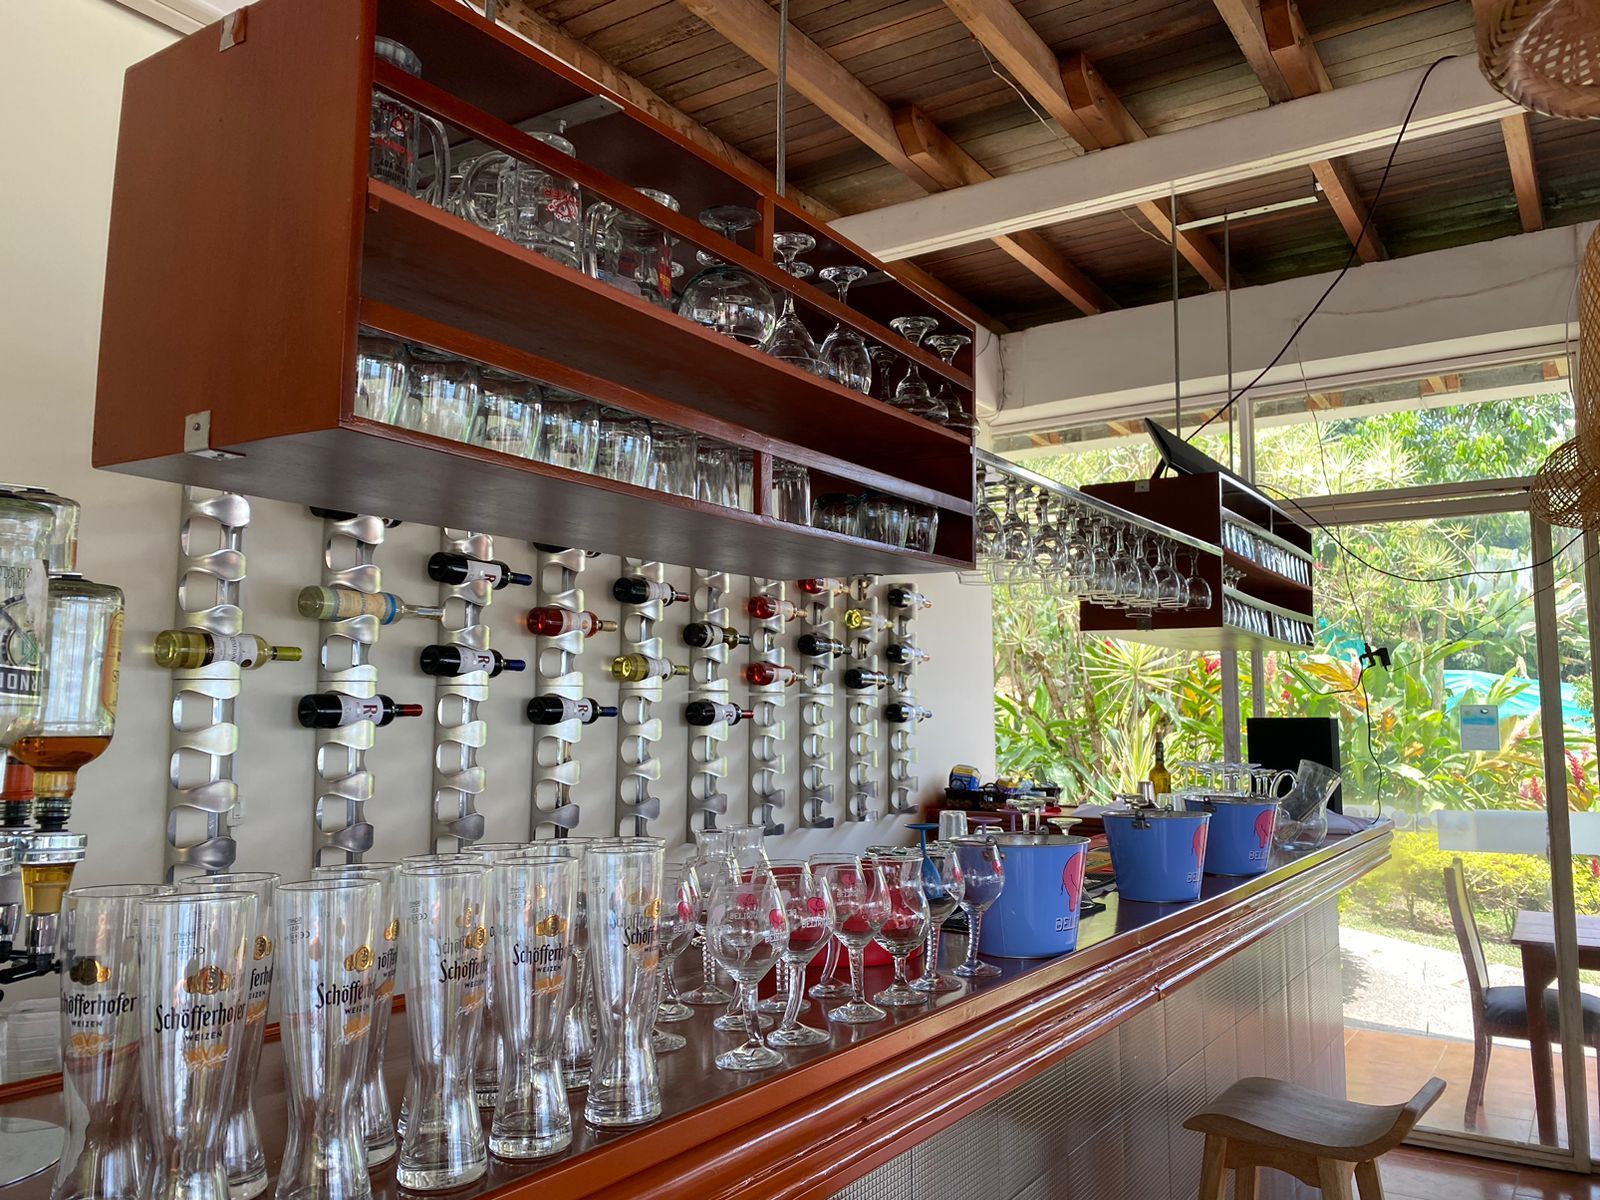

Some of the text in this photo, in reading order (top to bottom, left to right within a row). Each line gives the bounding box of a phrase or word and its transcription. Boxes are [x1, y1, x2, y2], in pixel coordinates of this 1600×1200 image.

[248, 990, 266, 1001] EIZEN
[155, 1000, 246, 1034] Schöfferhofer
[71, 1020, 102, 1028] WEIZEN
[185, 1031, 223, 1041] WEIZEN
